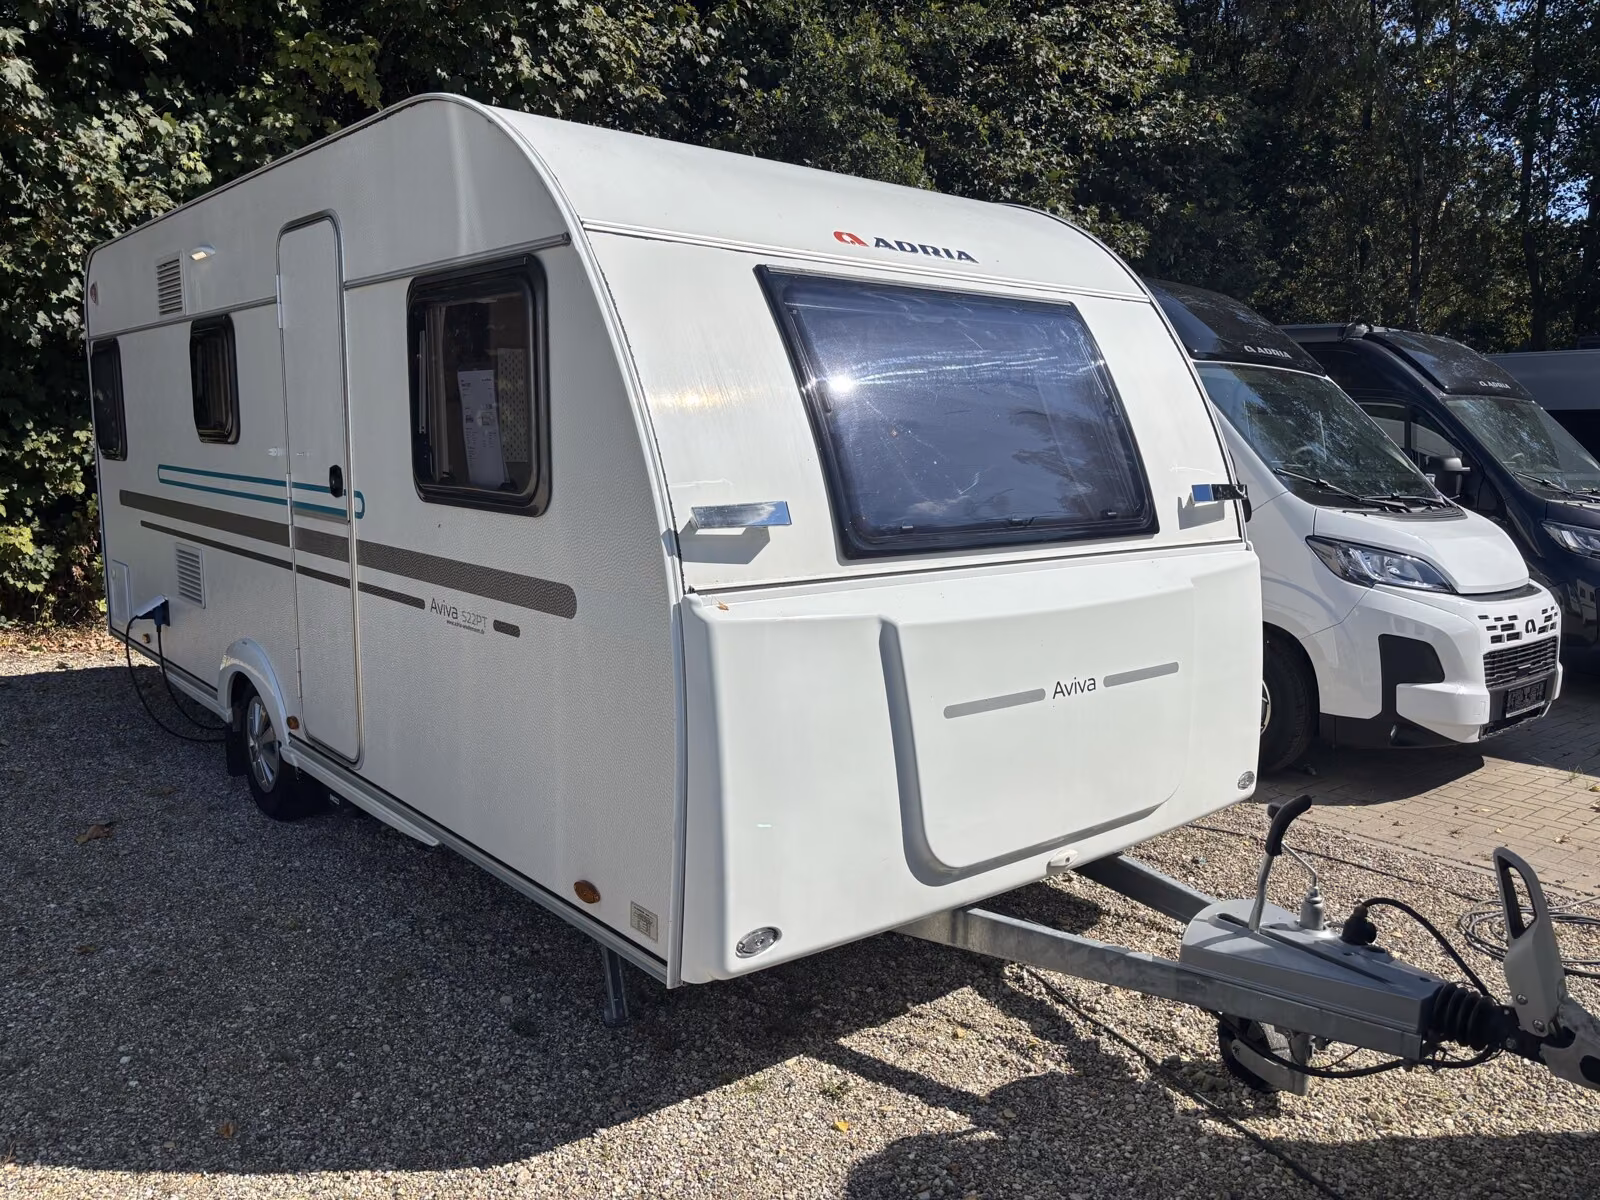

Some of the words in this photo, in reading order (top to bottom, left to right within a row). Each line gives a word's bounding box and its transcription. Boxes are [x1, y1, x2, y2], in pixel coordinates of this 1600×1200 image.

[874, 236, 980, 264] ADRIA
[1257, 347, 1293, 359] ADRIA
[430, 598, 459, 620] Aviva
[461, 611, 488, 628] 522PT
[1052, 676, 1097, 700] Aviva
